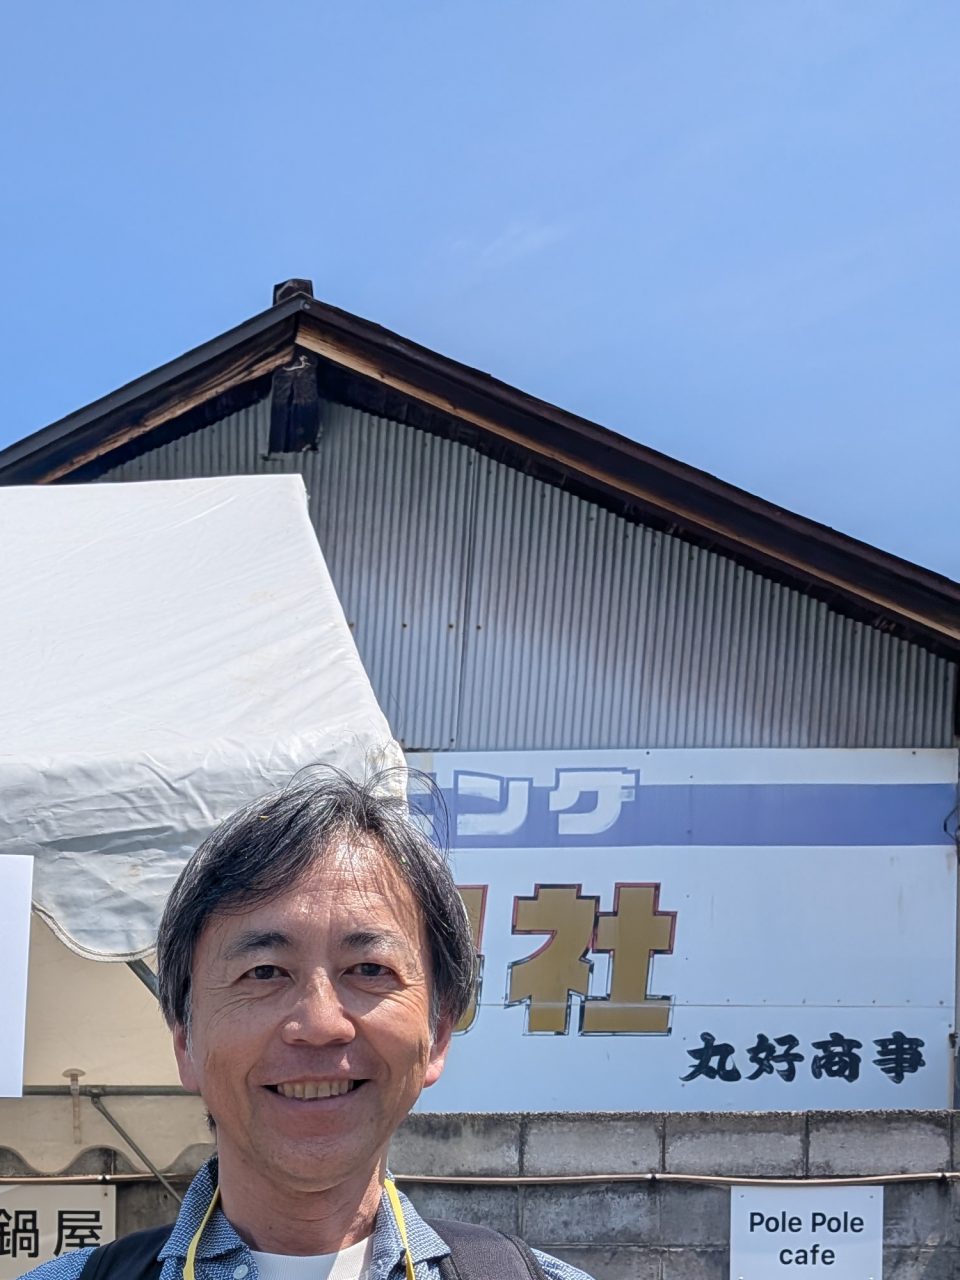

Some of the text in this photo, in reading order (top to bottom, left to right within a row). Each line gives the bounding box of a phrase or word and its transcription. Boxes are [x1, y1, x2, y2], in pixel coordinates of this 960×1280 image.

[412, 766, 640, 837] ング
[453, 882, 677, 1037] 社
[680, 1031, 926, 1084] 丸好商事
[749, 1211, 865, 1233] Pole Pole
[779, 1243, 836, 1266] cafe
